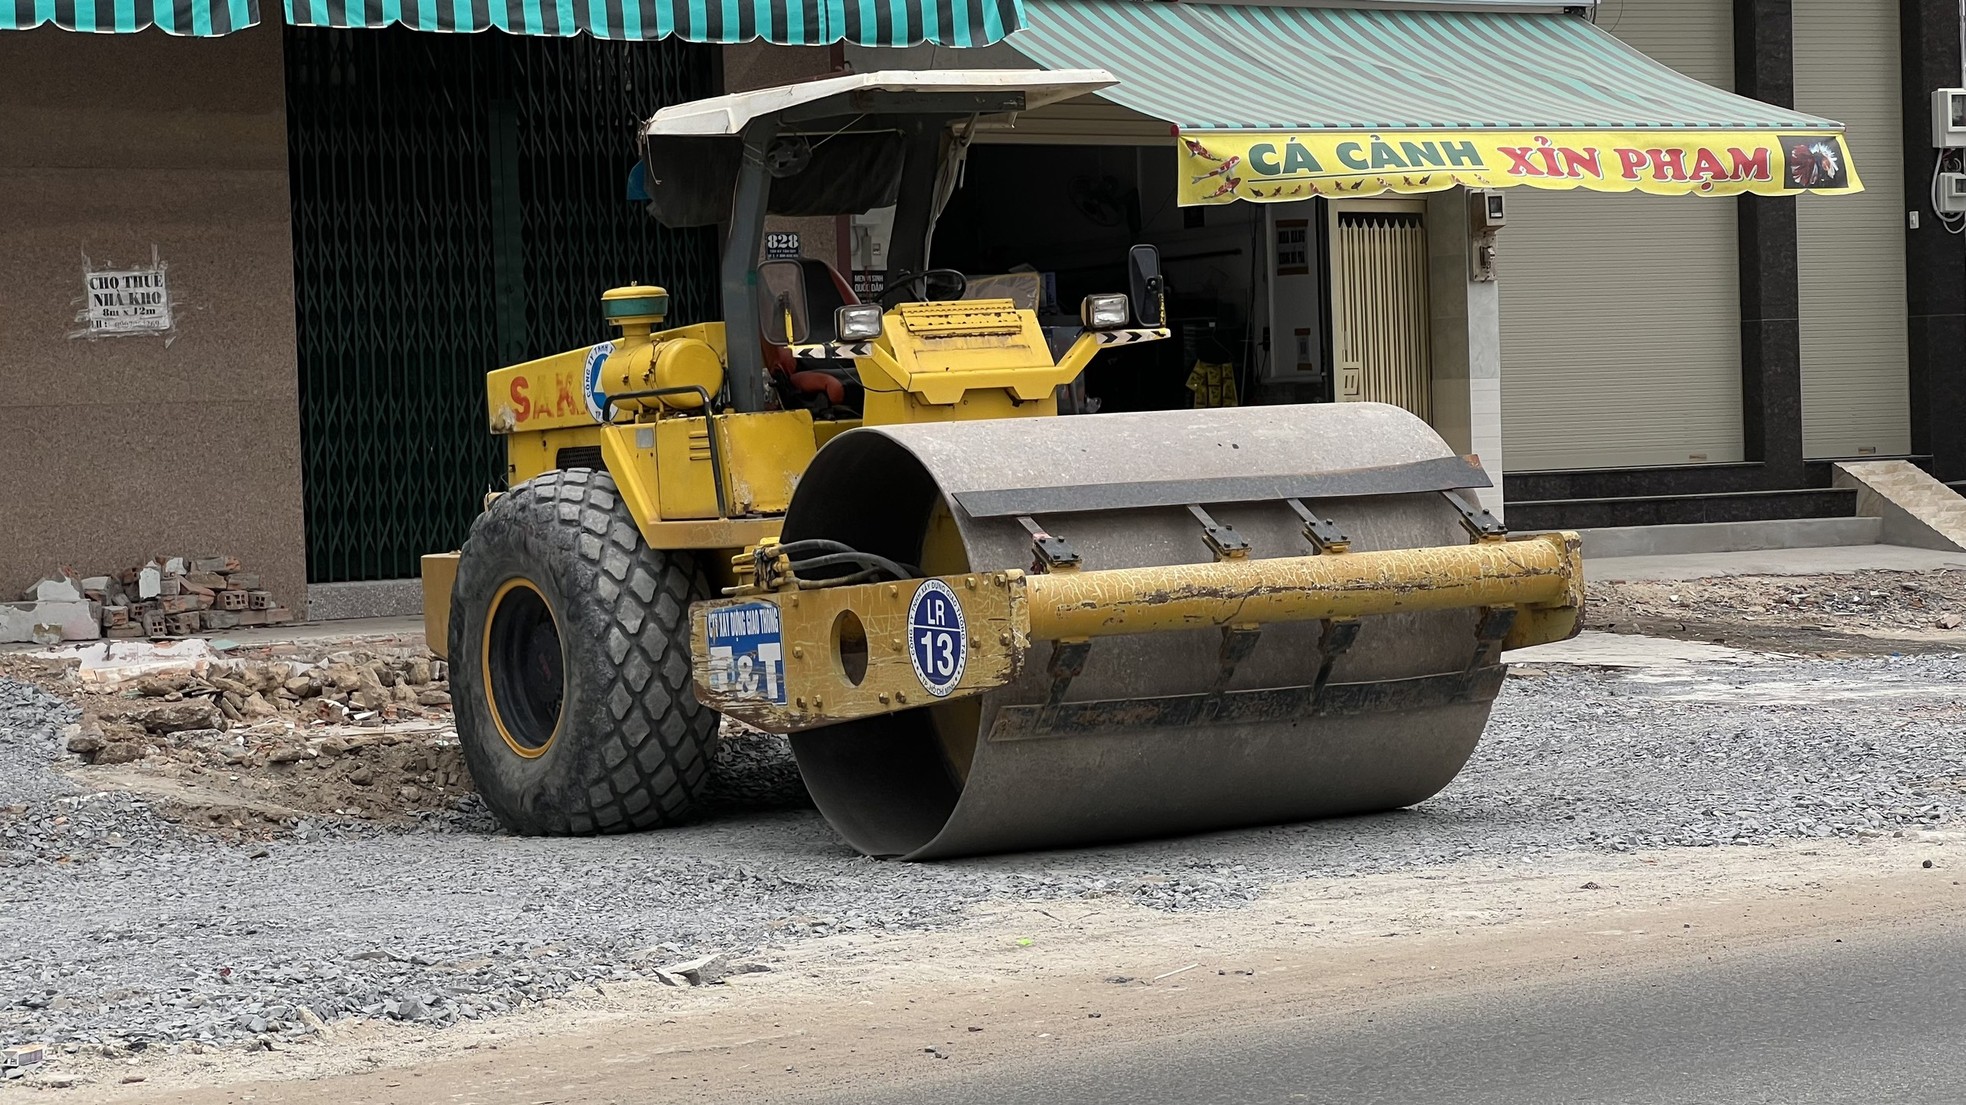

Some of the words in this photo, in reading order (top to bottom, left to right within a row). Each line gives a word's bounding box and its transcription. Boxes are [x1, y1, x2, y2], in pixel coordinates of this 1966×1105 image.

[1247, 136, 1323, 176] CÁ
[1336, 134, 1484, 171] CẢNH
[1497, 135, 1603, 179] XỈN
[1613, 147, 1772, 192] PHẠM
[767, 234, 799, 249] 828
[123, 272, 163, 289] THUÊ
[94, 289, 124, 307] NHÀ
[128, 291, 162, 305] KHO
[103, 308, 119, 317] 8m
[911, 593, 922, 612] TNHH
[945, 589, 958, 607] GIAO
[927, 598, 945, 626] LR
[746, 609, 760, 635] GIAO
[921, 631, 954, 677] 13
